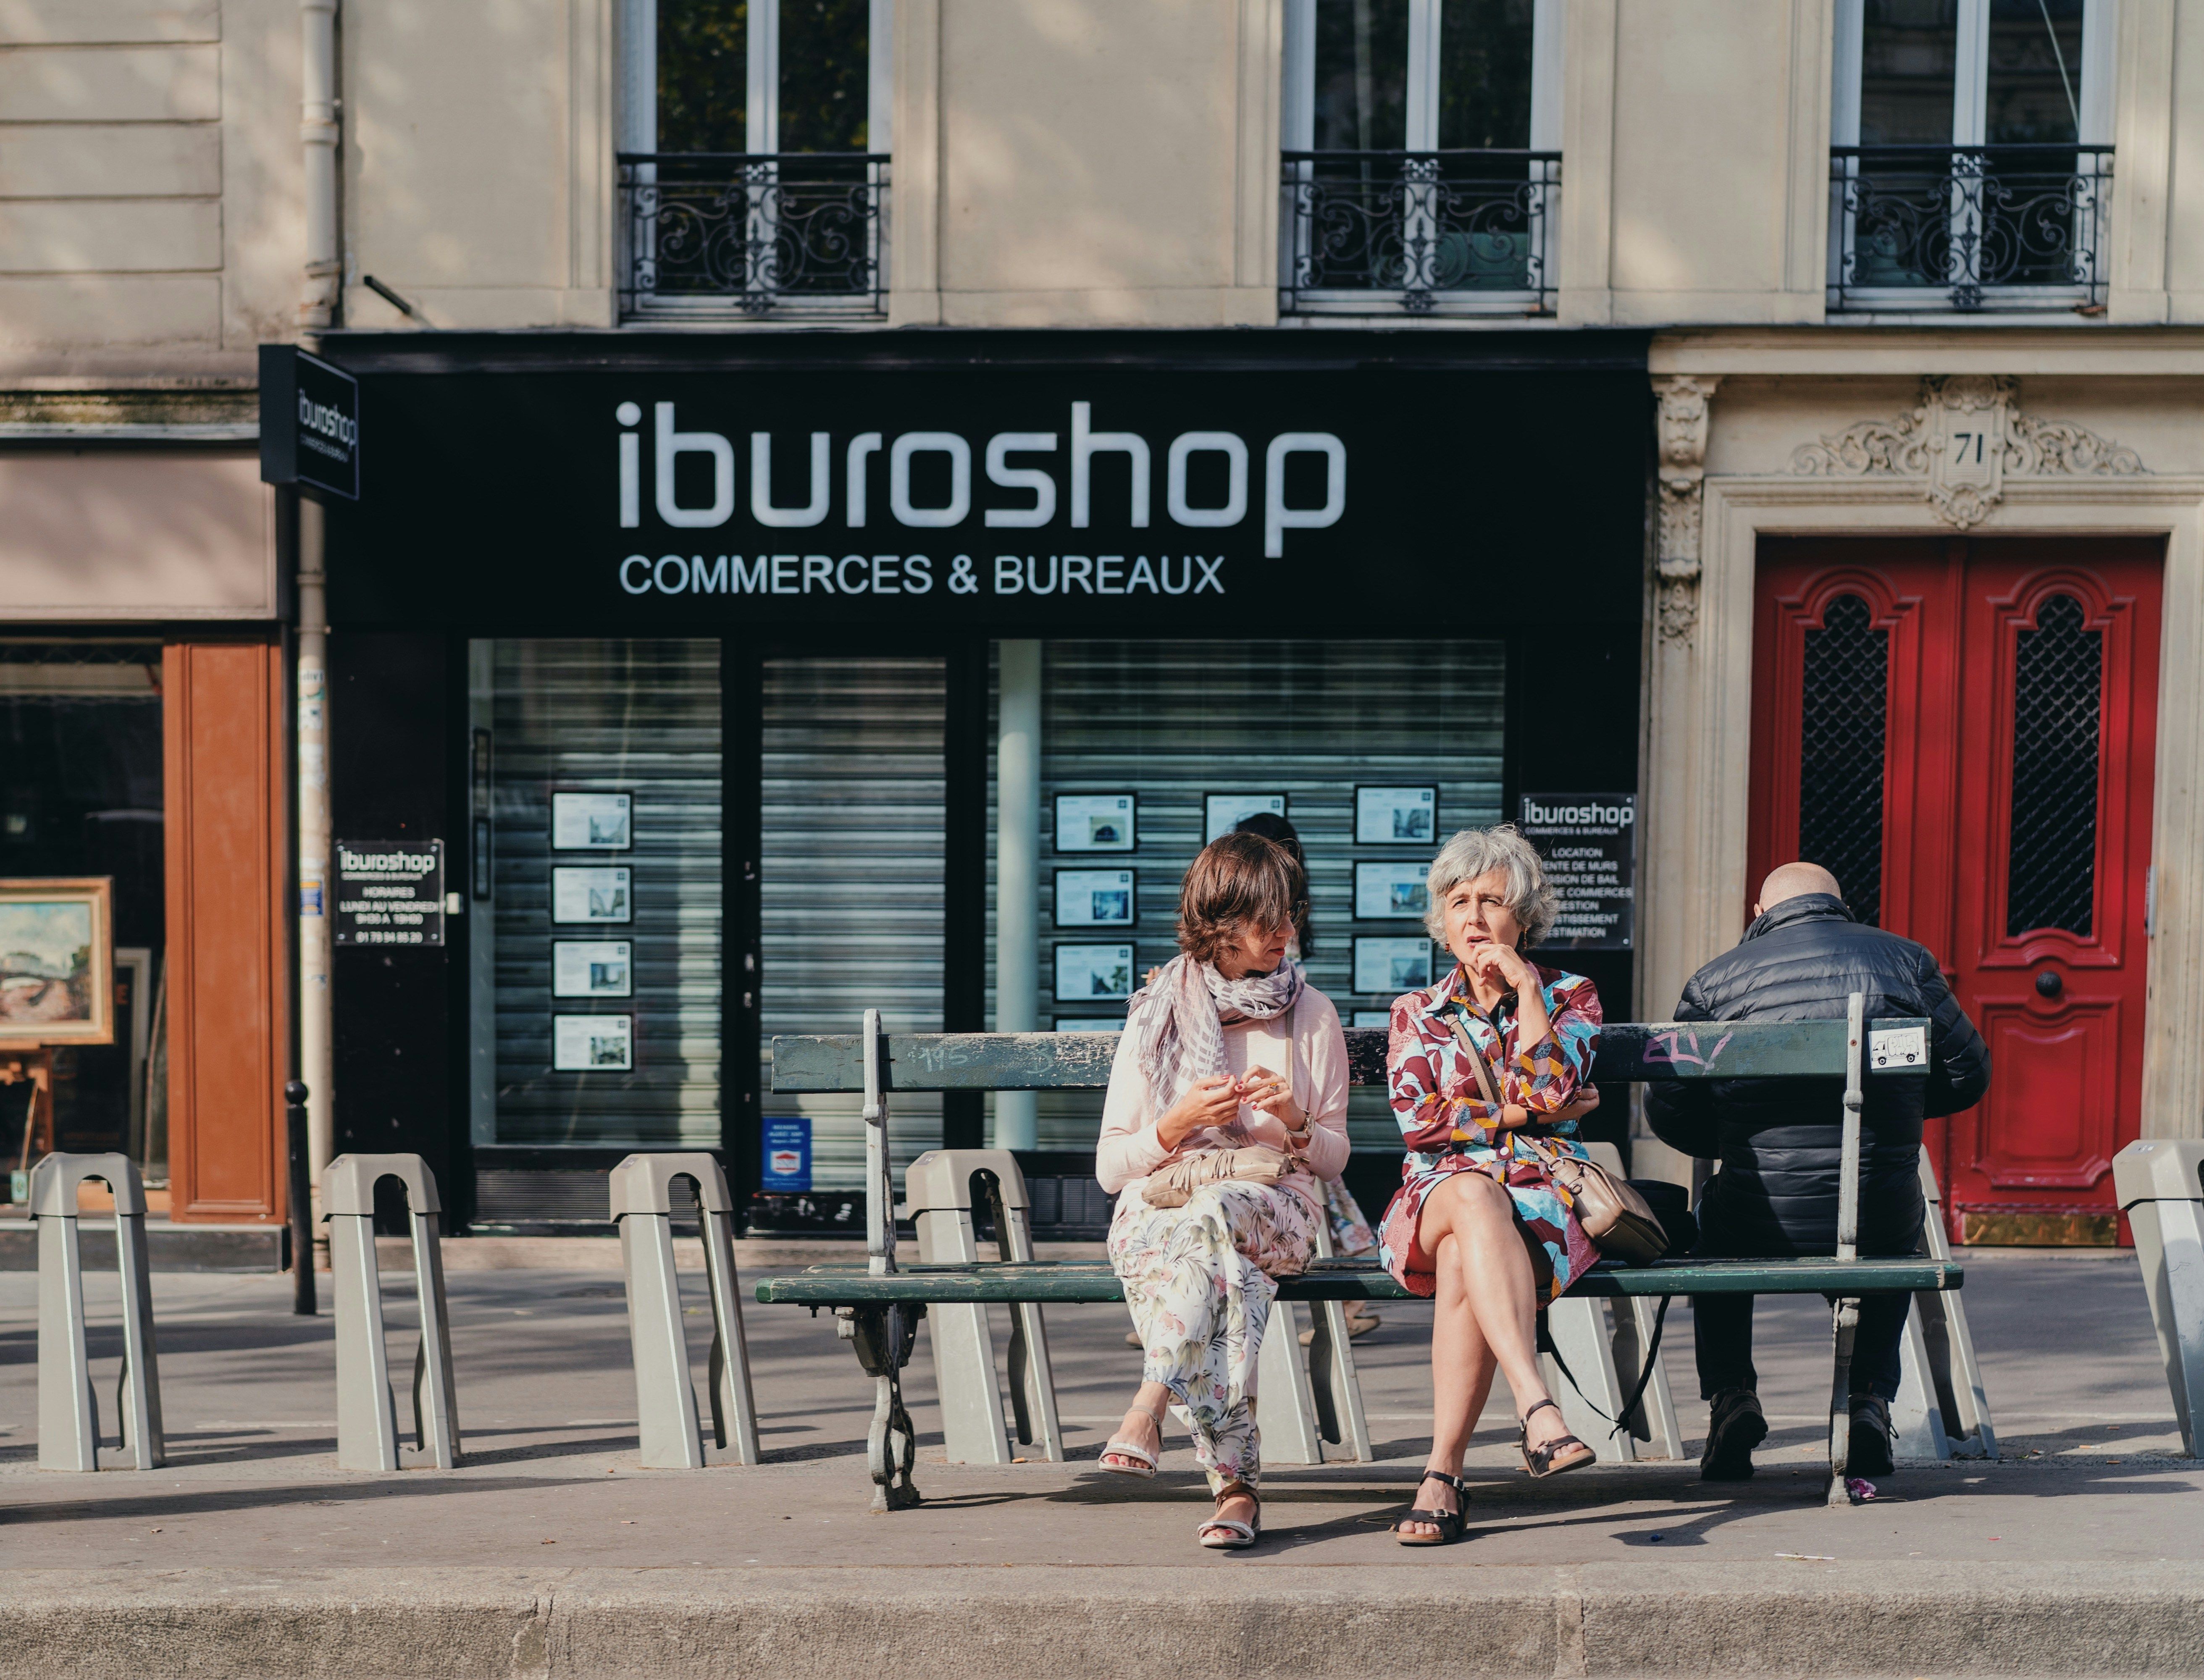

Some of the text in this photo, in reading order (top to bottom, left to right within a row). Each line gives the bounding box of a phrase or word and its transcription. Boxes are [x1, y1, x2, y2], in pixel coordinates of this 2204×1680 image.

[298, 388, 356, 452] iburoshop
[1954, 434, 1983, 464] 71
[616, 401, 1347, 558] iburoshop
[620, 554, 1225, 596] COMMERCES & BUREAUX
[1524, 802, 1634, 828] iburoshop
[1524, 827, 1574, 835] COMMERCES
[1582, 827, 1619, 835] BUREAUX
[1552, 848, 1603, 858] LOCATION
[340, 850, 436, 875] iburoshop
[1541, 861, 1618, 872] ENTE DE MURS
[1547, 874, 1619, 885] SSION DE BAIL
[362, 886, 416, 898] HORAIRES
[1566, 887, 1633, 898] COMMERCES
[339, 901, 371, 913] LUNDI
[371, 901, 387, 913] AU
[1558, 900, 1599, 911] ESTION
[1554, 914, 1619, 924] STISSEMENT
[1546, 927, 1606, 938] ESTIMATION
